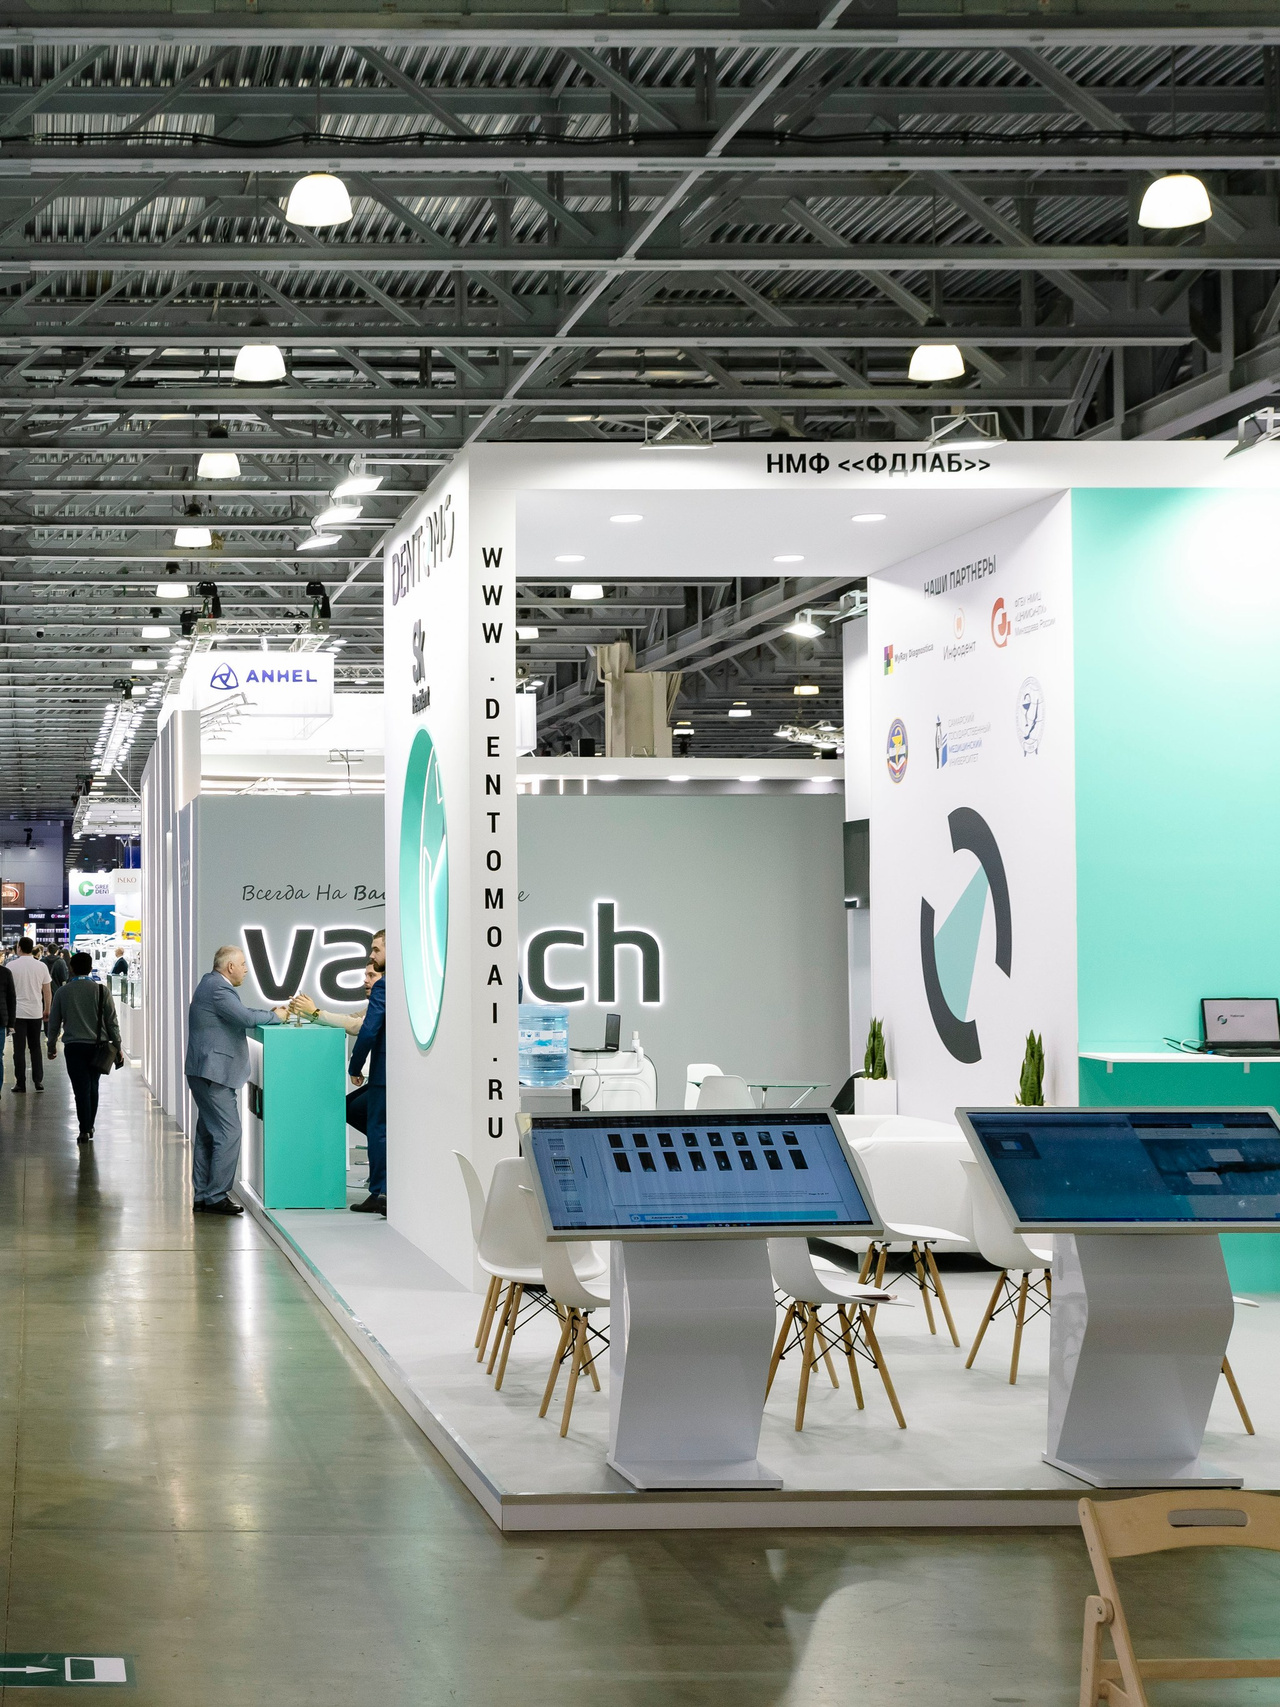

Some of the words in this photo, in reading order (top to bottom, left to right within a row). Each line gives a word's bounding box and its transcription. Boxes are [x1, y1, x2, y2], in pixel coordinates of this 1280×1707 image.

[766, 453, 830, 473] НМФ
[923, 573, 948, 600] НАШИ
[949, 554, 997, 591] ПАРТНЕРЫ
[246, 669, 318, 683] ANHEL
[241, 884, 310, 901] Всегда
[316, 883, 347, 901] На
